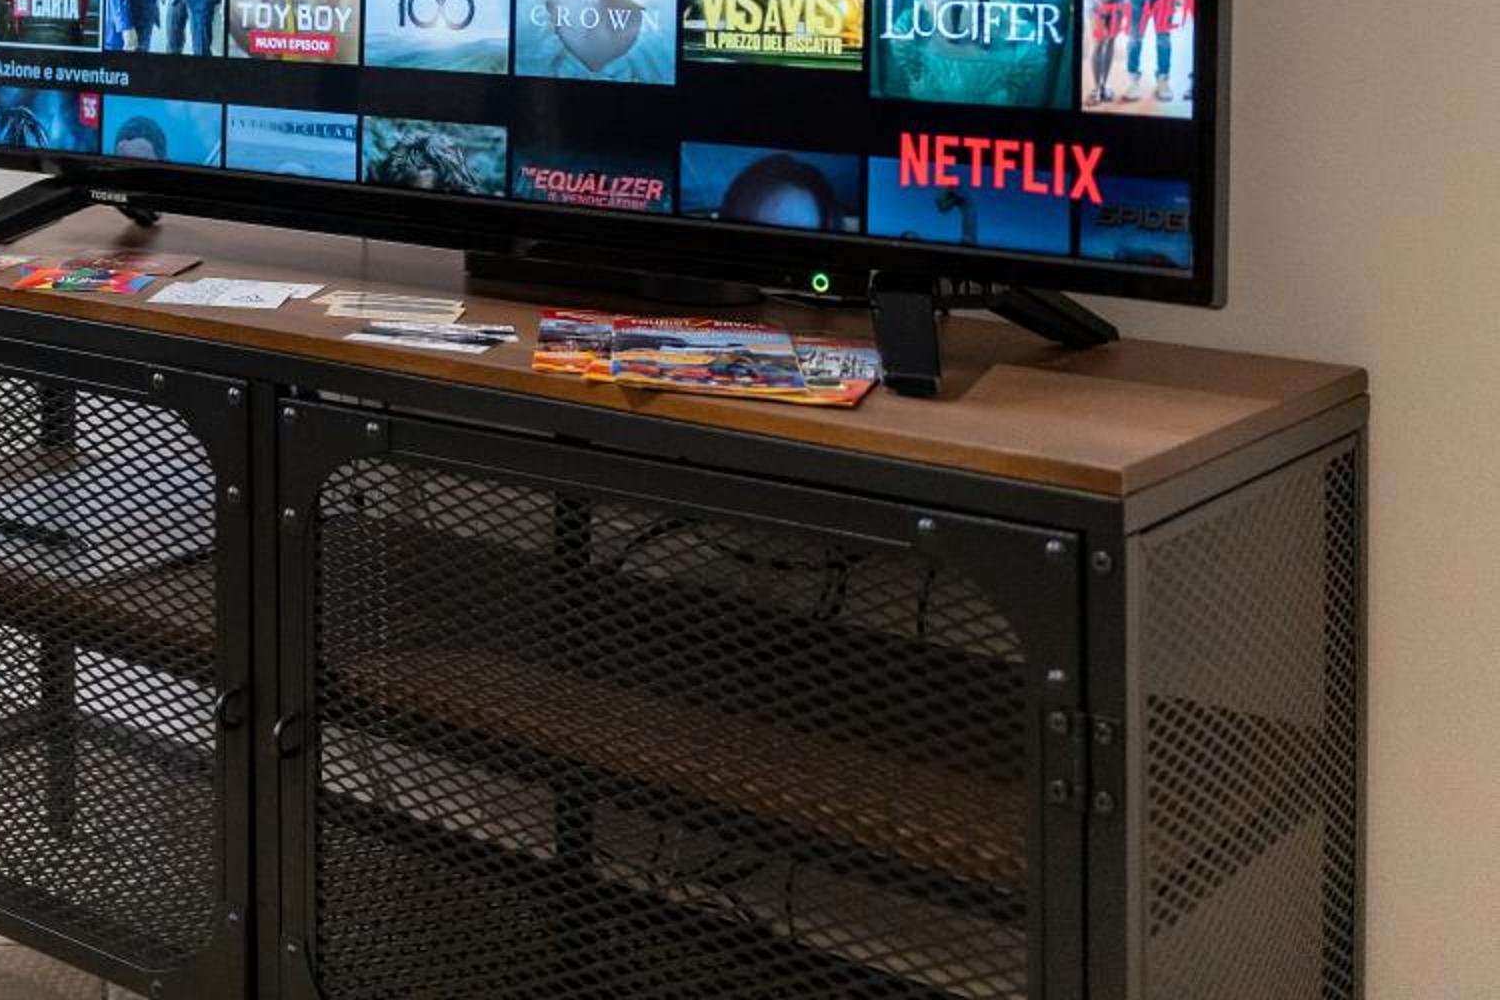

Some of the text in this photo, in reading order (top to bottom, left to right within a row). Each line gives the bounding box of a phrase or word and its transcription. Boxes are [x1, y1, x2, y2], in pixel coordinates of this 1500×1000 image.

[238, 1, 352, 33] TOY BOY
[530, 5, 660, 32] CROWN
[763, 5, 783, 34] A
[763, 34, 785, 52] DEL
[43, 67, 53, 80] e
[55, 64, 130, 86] avventura
[900, 132, 1104, 205] NETFLIX
[533, 168, 665, 201] EQUALIZER
